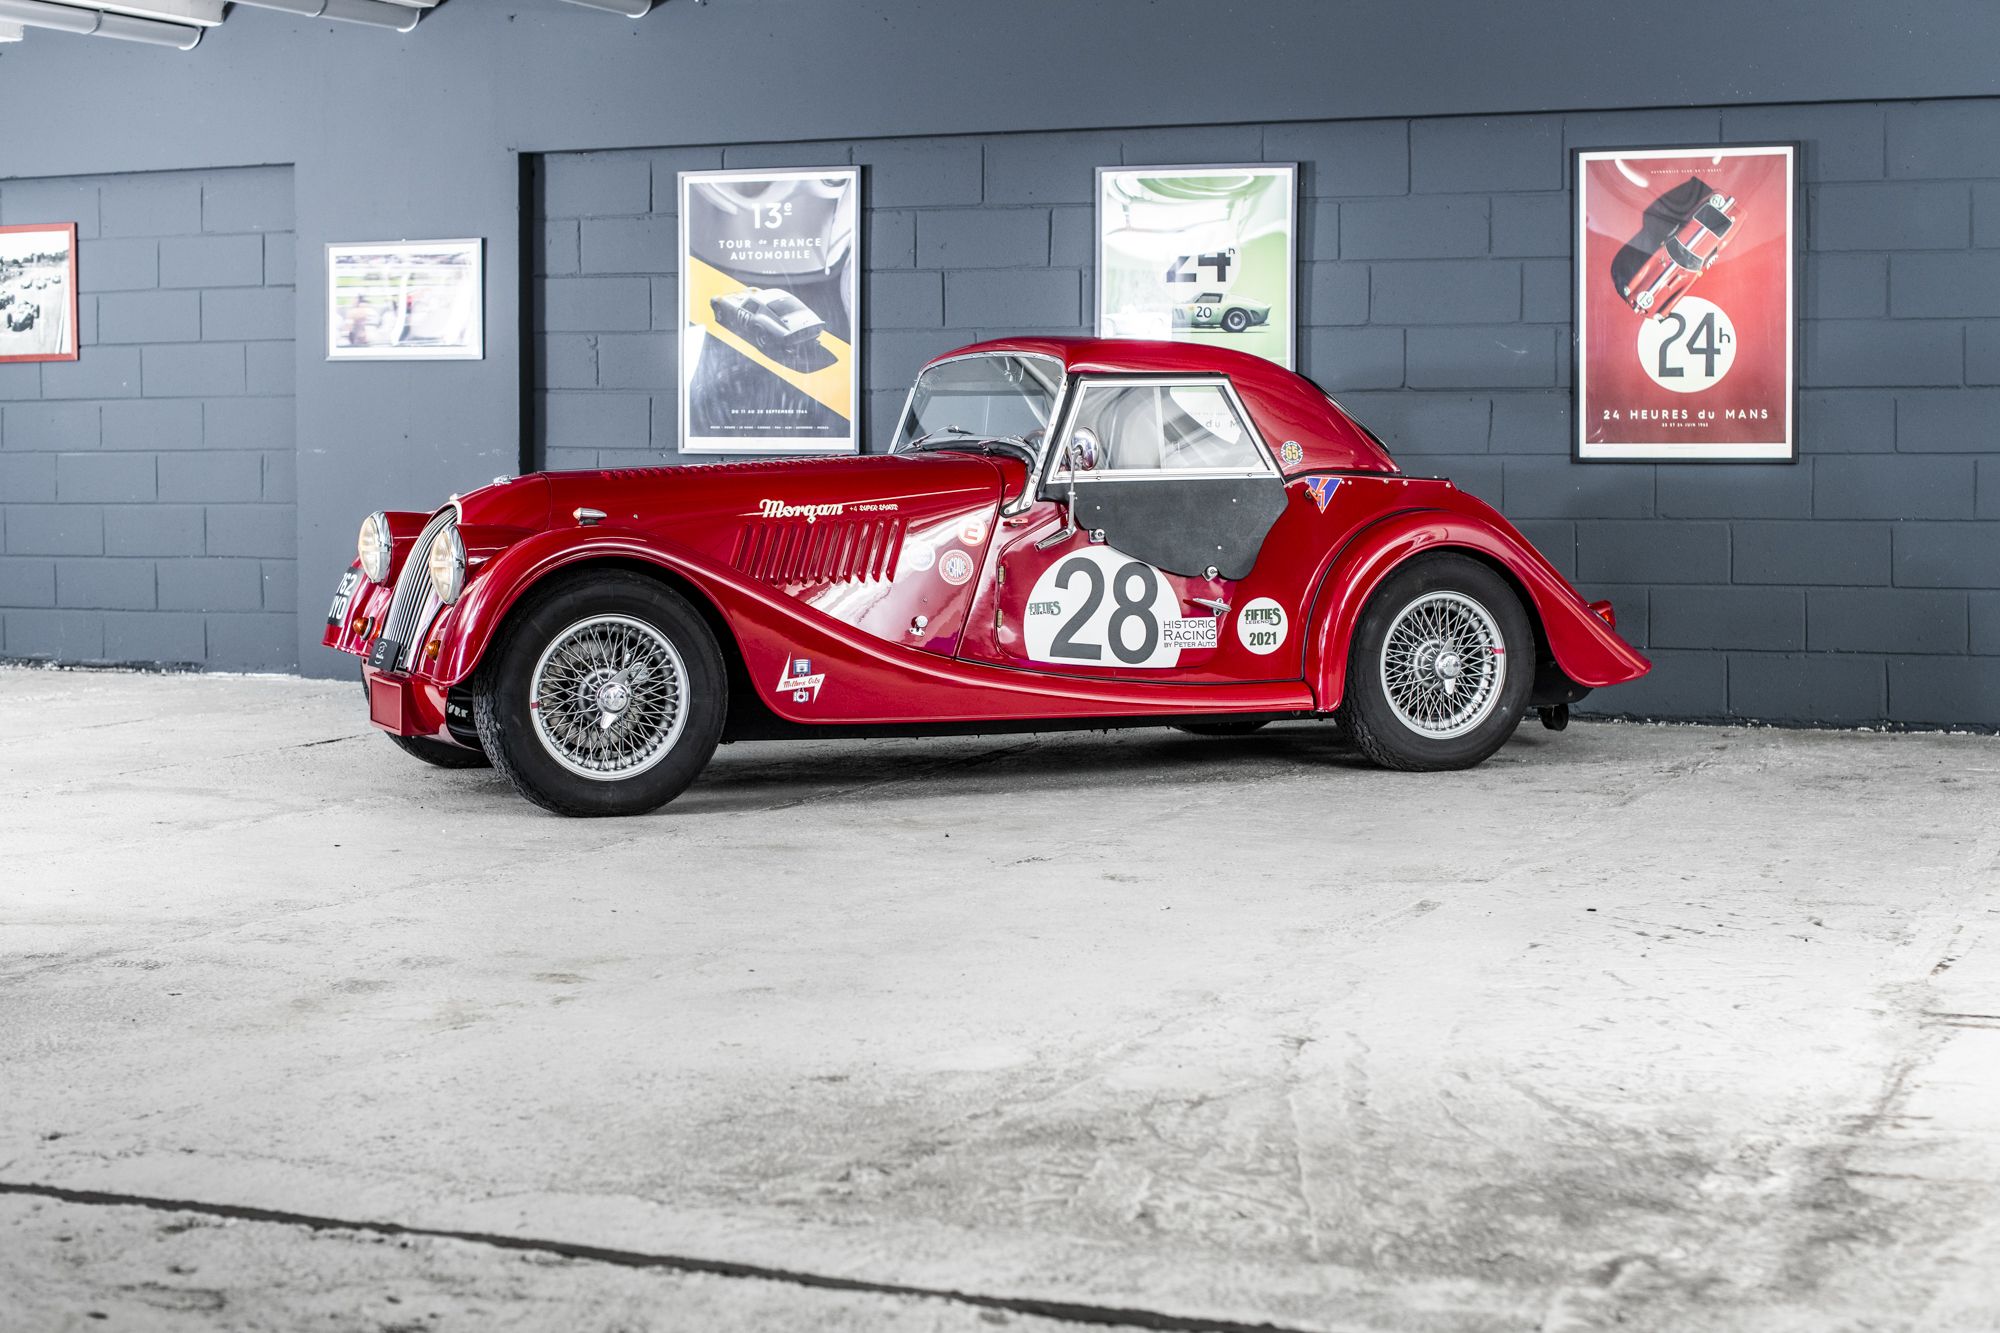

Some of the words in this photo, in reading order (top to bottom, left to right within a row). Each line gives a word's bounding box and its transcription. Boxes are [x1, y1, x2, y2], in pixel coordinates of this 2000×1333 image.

[719, 240, 751, 249] TOUR
[773, 238, 821, 248] FRANCE
[730, 250, 810, 260] AUTOMOBILE
[1196, 306, 1212, 319] 20
[1658, 312, 1731, 377] 24h
[1603, 410, 1620, 420] 24
[1630, 410, 1689, 420] HEURES
[1698, 410, 1715, 420] du
[1725, 409, 1769, 420] MANS
[1286, 446, 1299, 460] 65
[759, 499, 843, 524] Morgan
[1029, 601, 1061, 615] FIFTIES
[1050, 557, 1159, 664] 28
[1245, 608, 1281, 625] FIFTIES
[1163, 619, 1216, 629] HISTORIC
[1163, 630, 1216, 641] RACING
[1249, 632, 1277, 646] 2021
